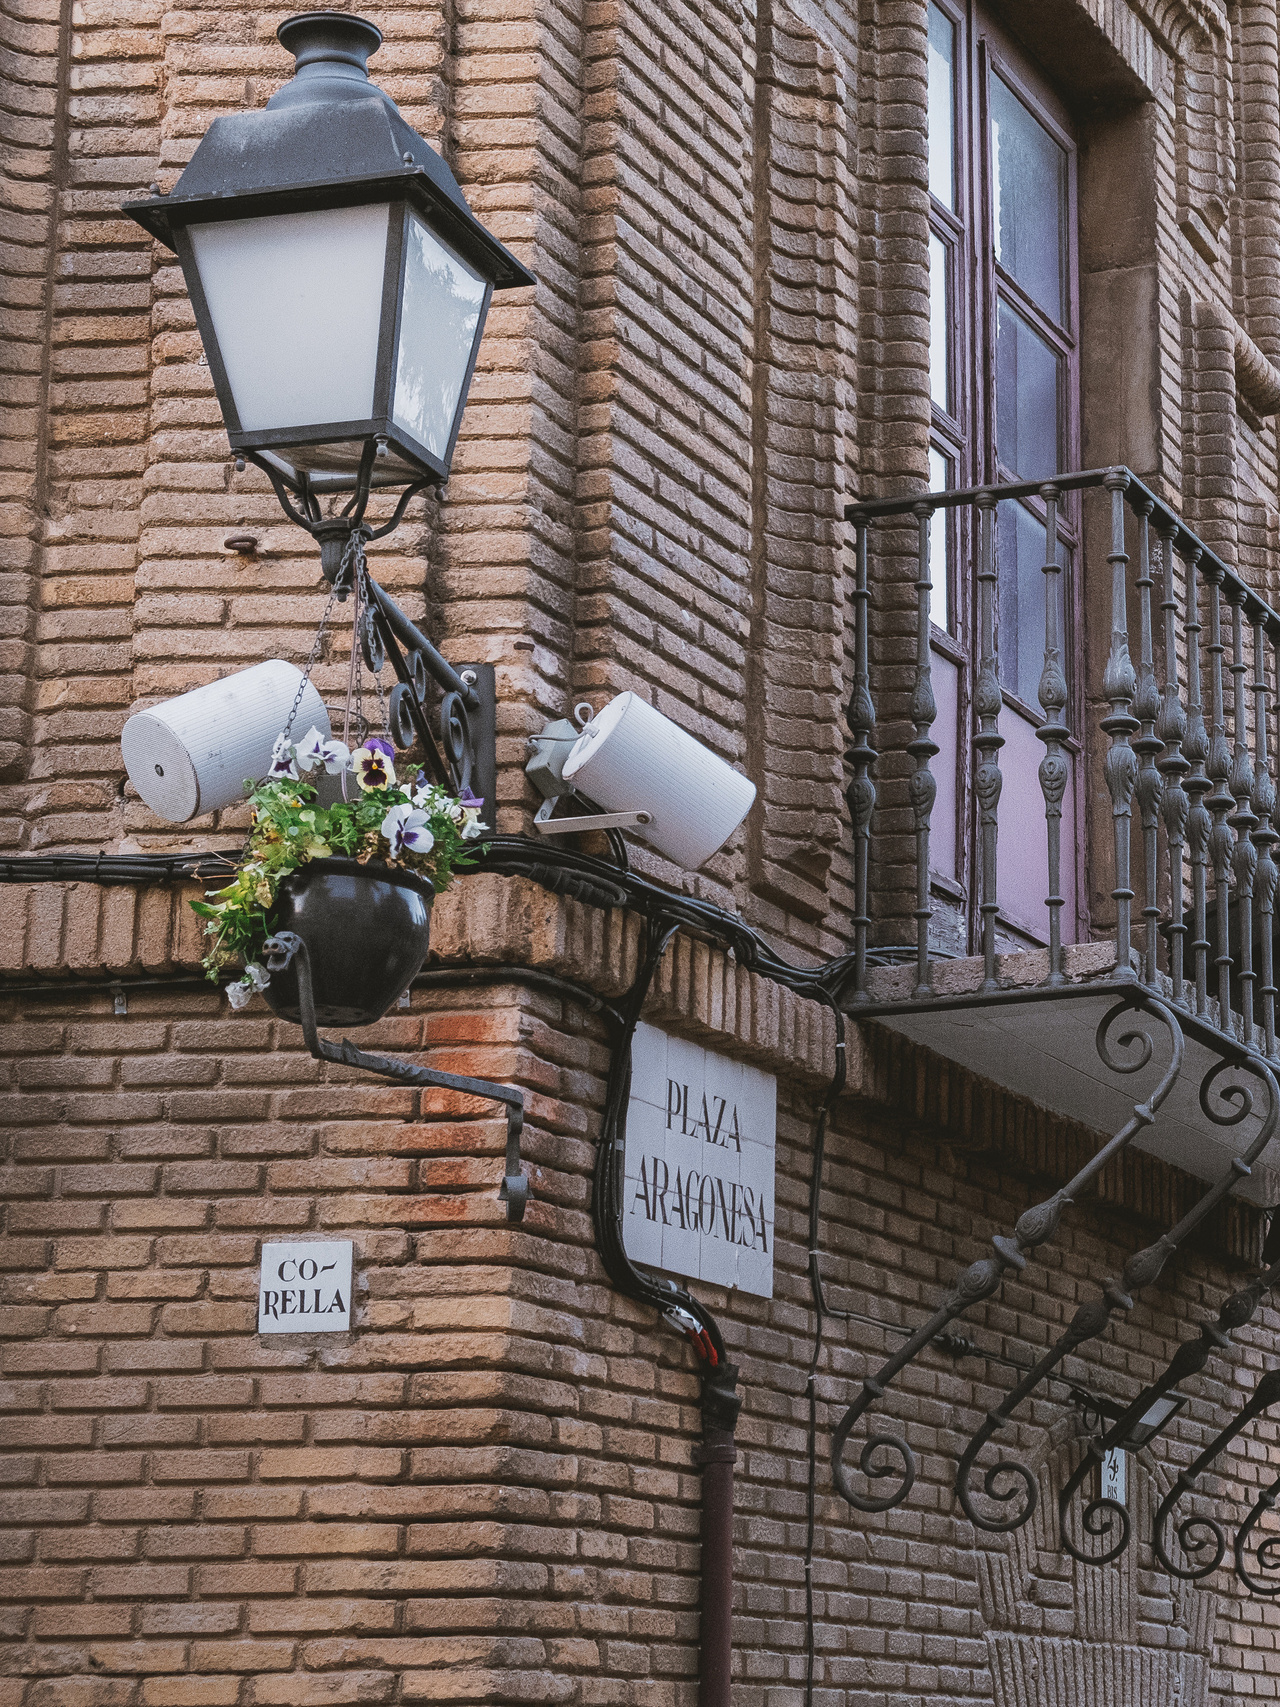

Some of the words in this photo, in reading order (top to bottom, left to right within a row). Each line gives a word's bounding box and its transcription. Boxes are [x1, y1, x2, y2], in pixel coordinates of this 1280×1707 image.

[665, 1077, 743, 1153] PLAZA
[629, 1153, 769, 1254] ARAGONESA
[277, 1258, 338, 1283] CO-
[262, 1288, 347, 1321] RELLA
[1106, 1484, 1118, 1499] BIS
